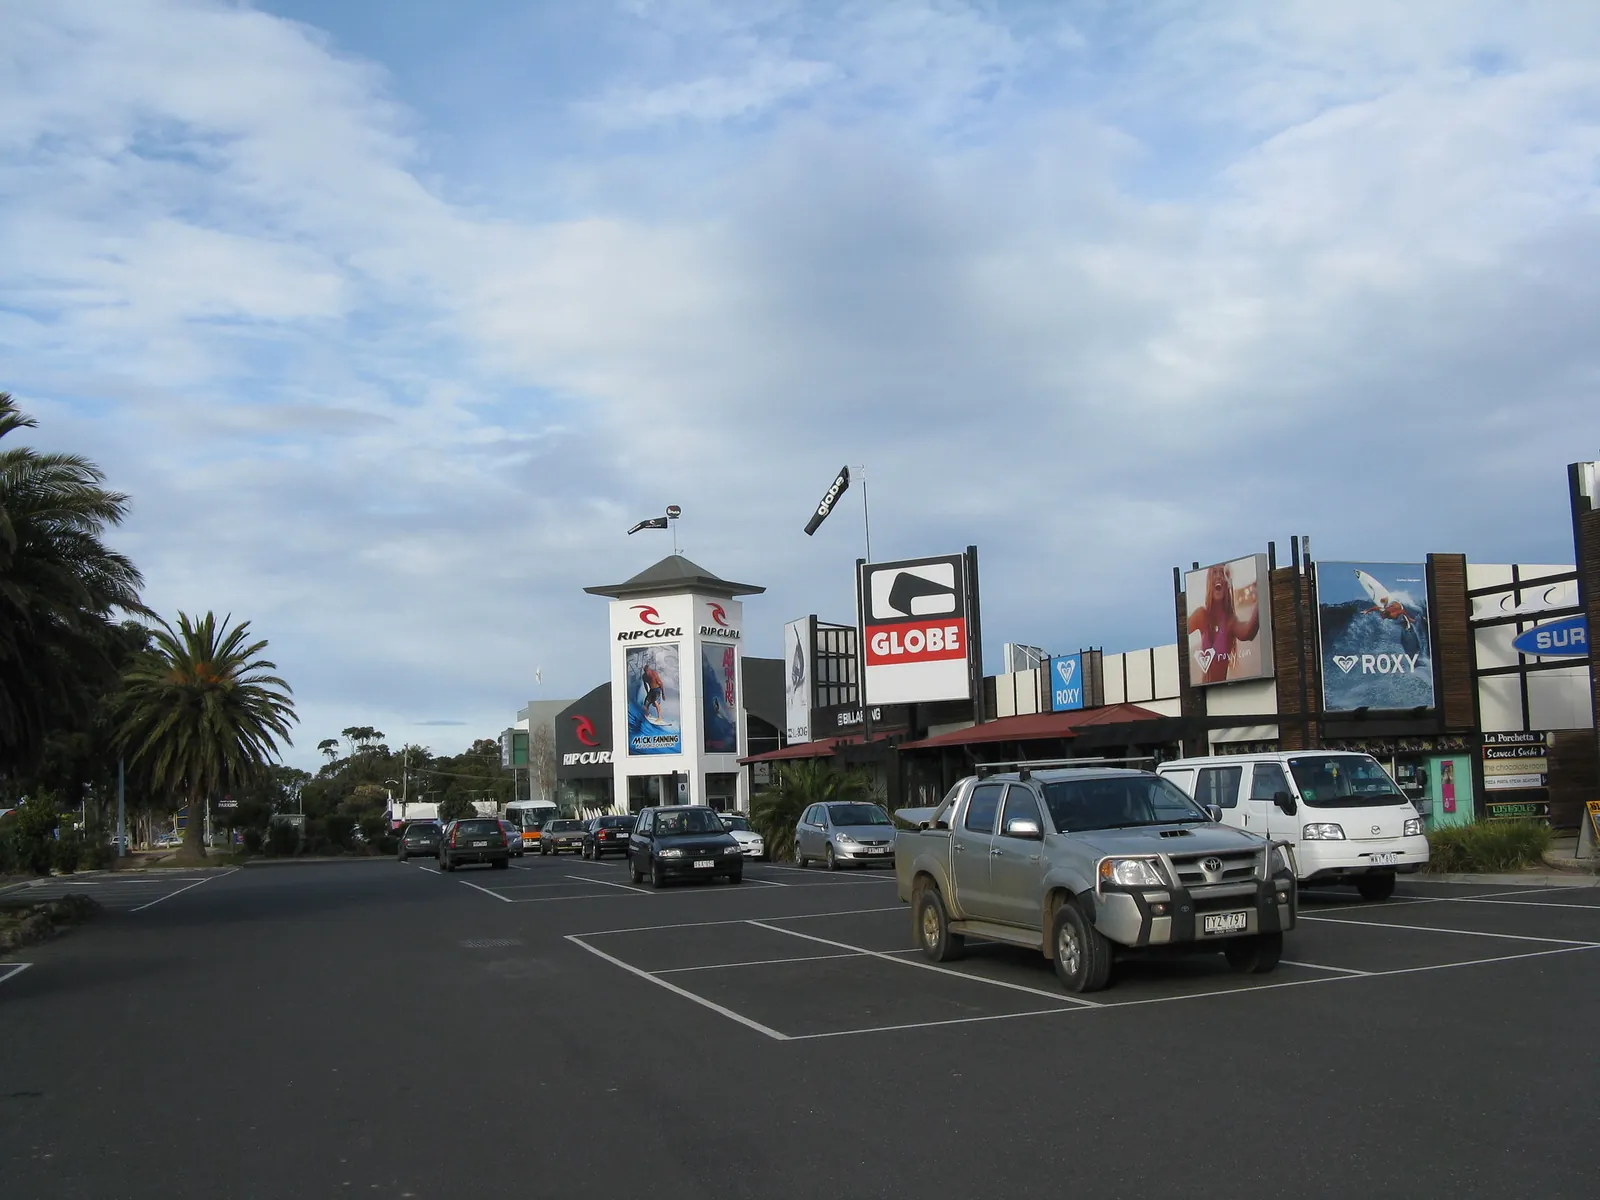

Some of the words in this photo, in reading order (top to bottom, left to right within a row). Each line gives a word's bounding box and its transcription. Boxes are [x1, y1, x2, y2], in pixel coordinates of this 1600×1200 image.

[818, 476, 844, 517] globe
[871, 626, 960, 656] GLOBE
[1536, 627, 1586, 649] SUR
[1361, 653, 1419, 674] ROXY
[1056, 688, 1080, 705] ROXY
[653, 734, 679, 743] FANNING
[1484, 734, 1496, 743] La
[1498, 733, 1535, 742] Porchetta
[1518, 748, 1538, 757] Sushi
[1496, 763, 1529, 771] chocolate
